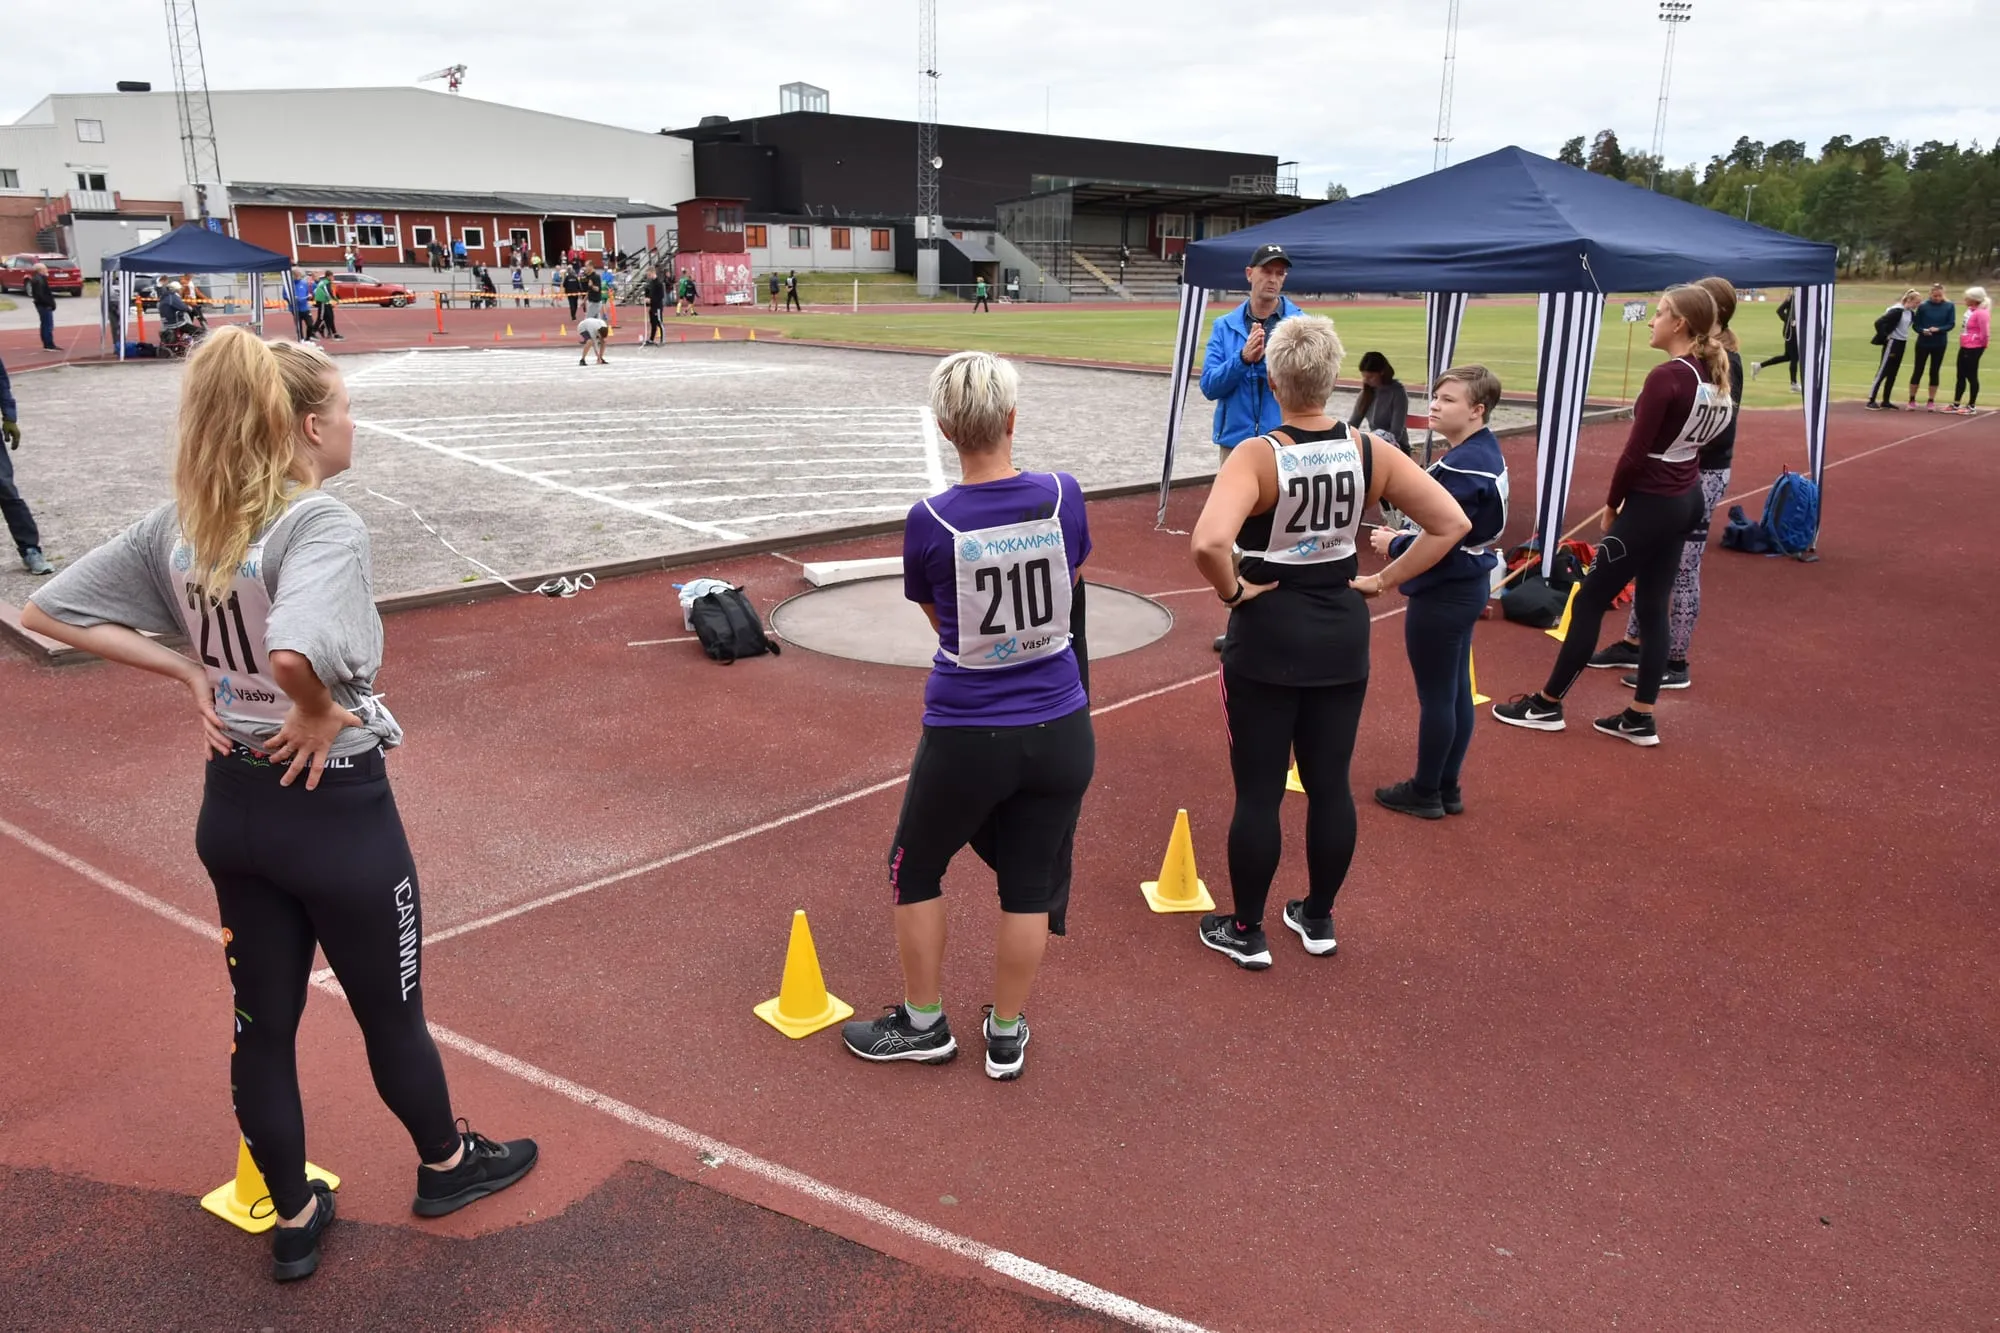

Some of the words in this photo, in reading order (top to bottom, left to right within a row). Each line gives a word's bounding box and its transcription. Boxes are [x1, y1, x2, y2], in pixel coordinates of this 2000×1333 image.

[1285, 470, 1355, 533] 209
[186, 581, 259, 674] 211
[975, 558, 1053, 635] 210
[235, 687, 275, 704] Väsby
[393, 876, 417, 1002] ICANIWILL
